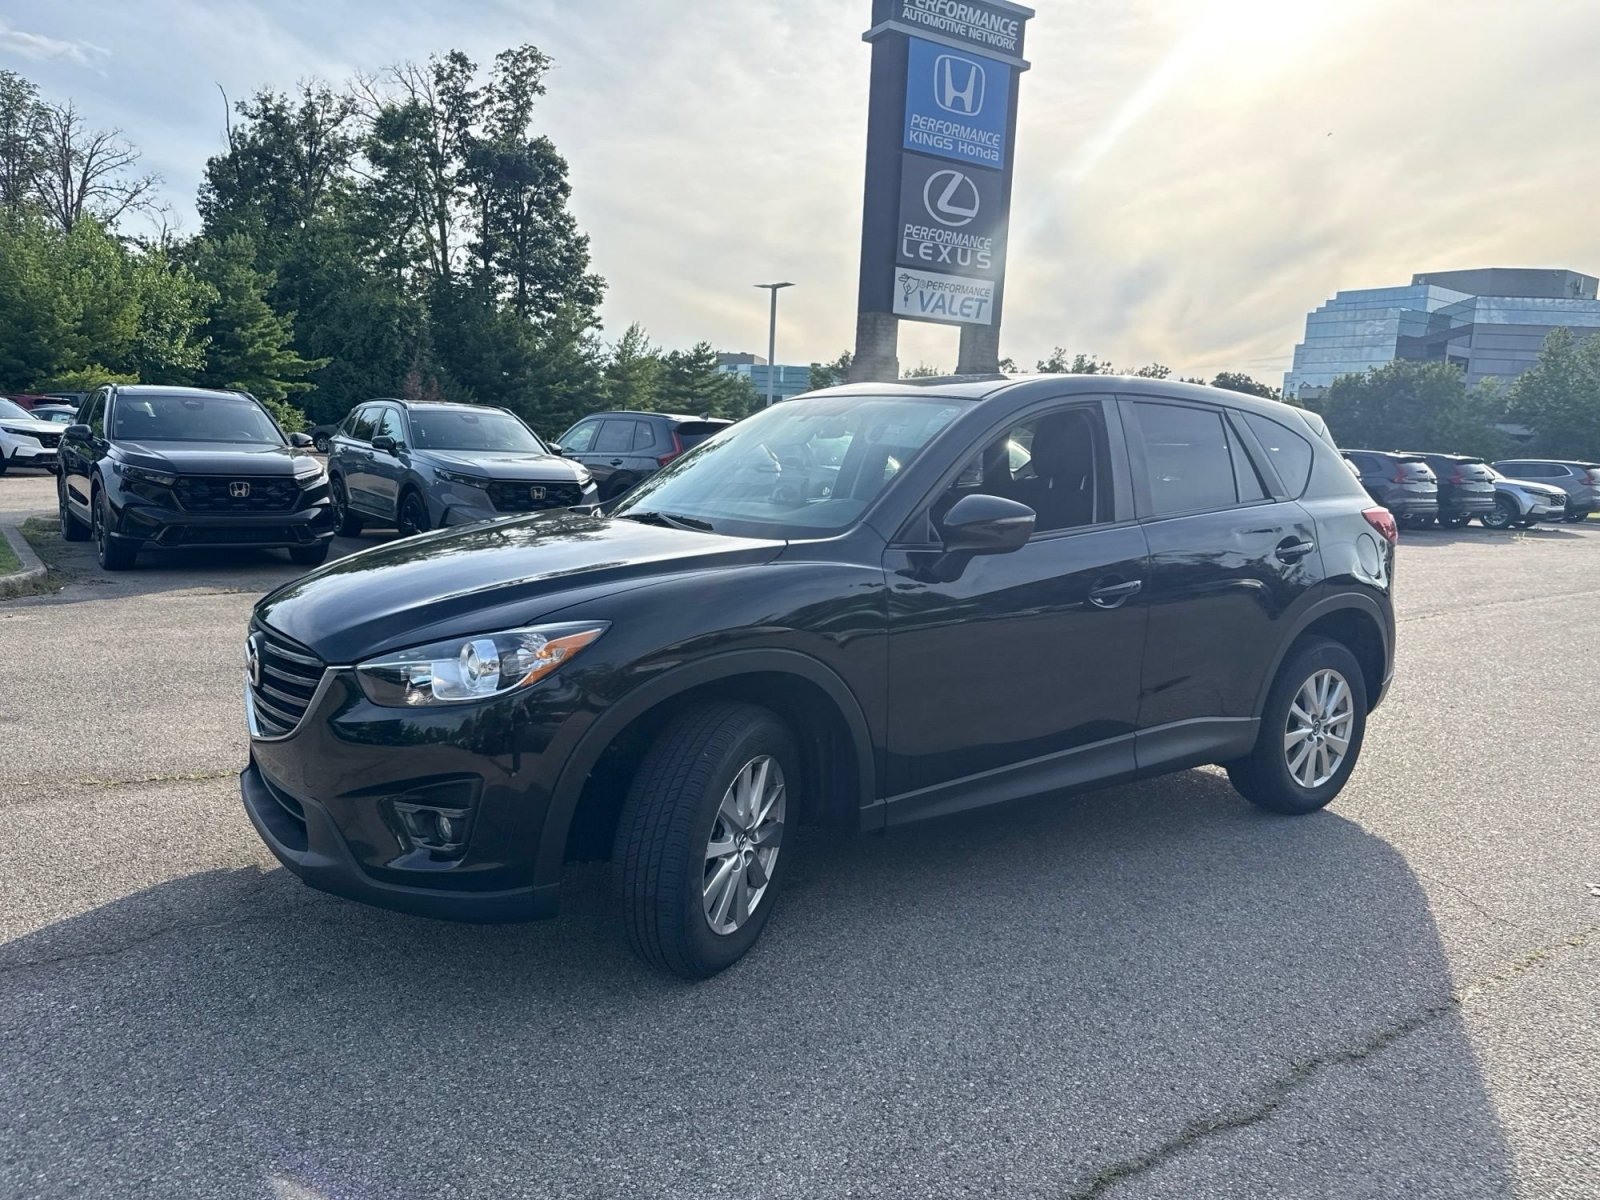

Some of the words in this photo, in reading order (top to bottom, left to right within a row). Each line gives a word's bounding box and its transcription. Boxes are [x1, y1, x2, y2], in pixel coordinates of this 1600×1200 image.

[902, 7, 966, 36] AUTOMOTIVE
[968, 27, 1016, 51] NETWORK
[903, 0, 1018, 36] ERFORMANCE
[909, 130, 953, 150] KINGS
[958, 141, 999, 161] Honda
[910, 114, 1001, 147] PERFORMANCE
[904, 223, 992, 250] PERFORMANCE
[902, 239, 992, 269] LEXUS
[926, 280, 991, 297] PERFORMANCE
[919, 290, 988, 319] VALET
